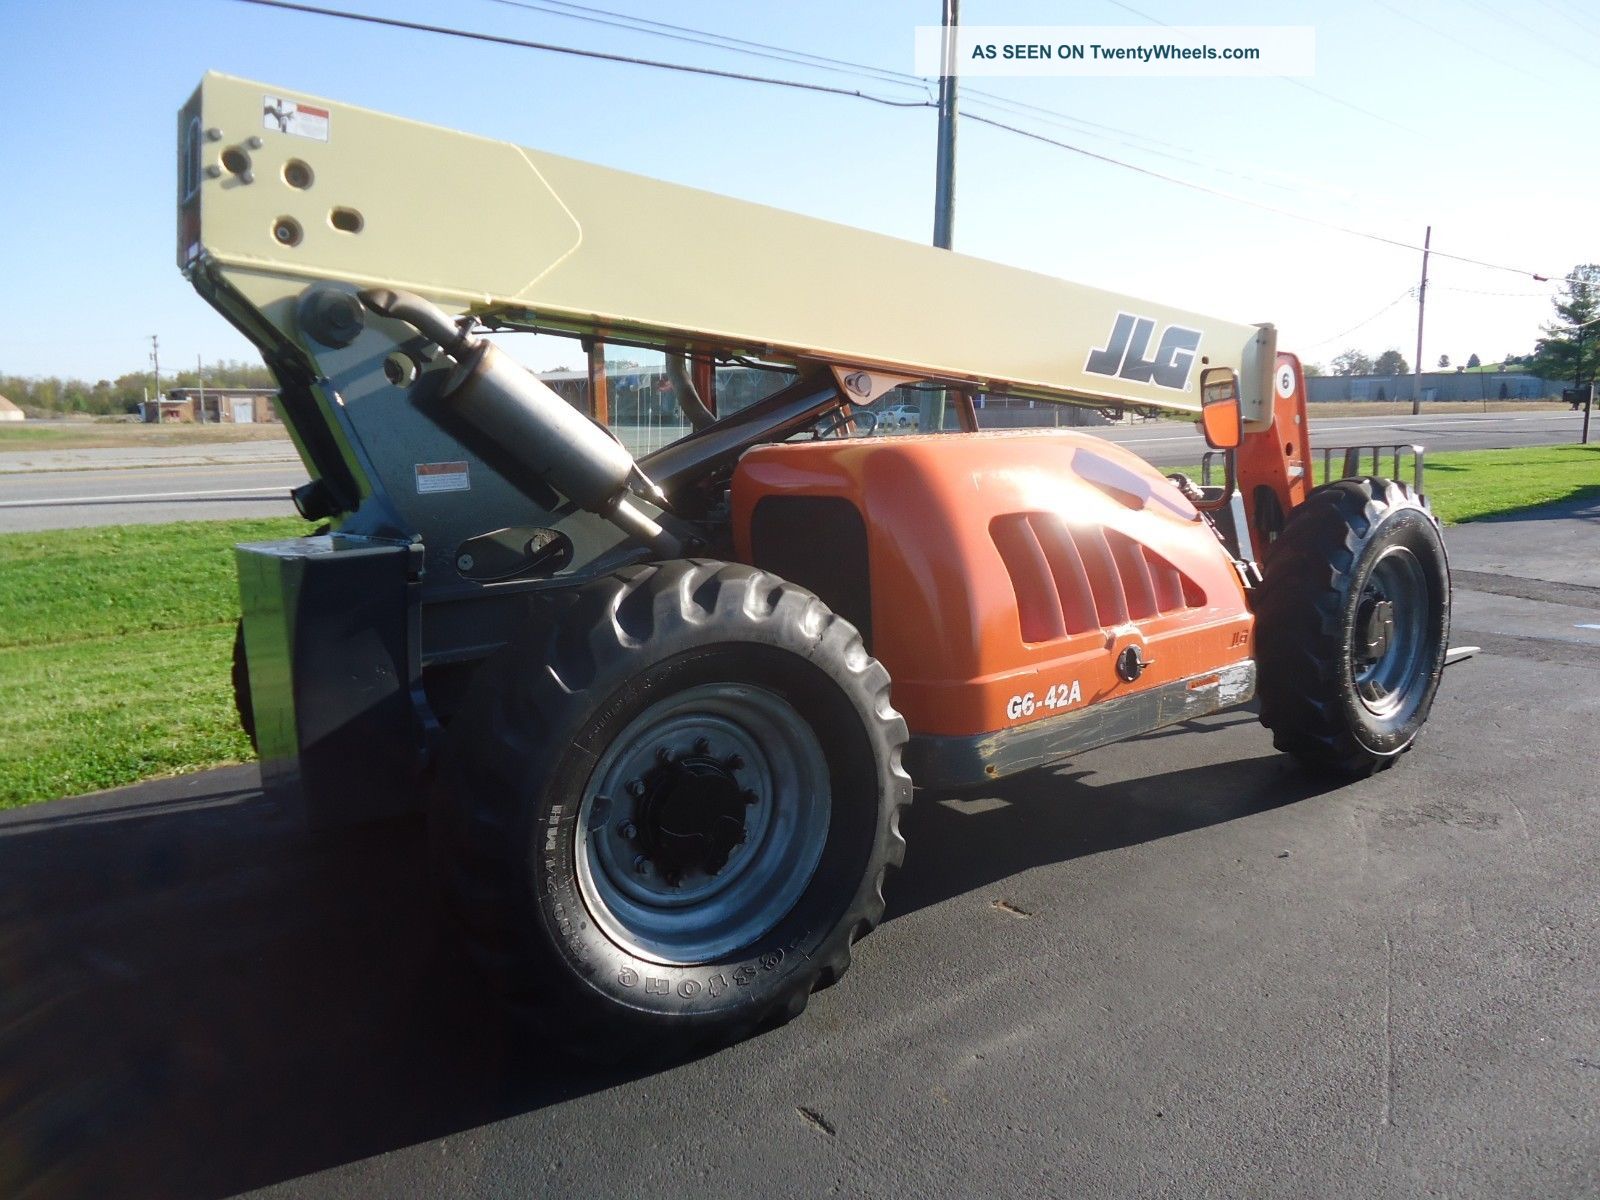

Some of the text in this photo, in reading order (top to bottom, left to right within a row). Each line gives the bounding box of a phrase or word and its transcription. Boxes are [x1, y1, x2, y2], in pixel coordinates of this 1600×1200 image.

[1084, 312, 1202, 392] JLG
[1281, 372, 1291, 390] 6
[1006, 680, 1082, 720] G6-42A
